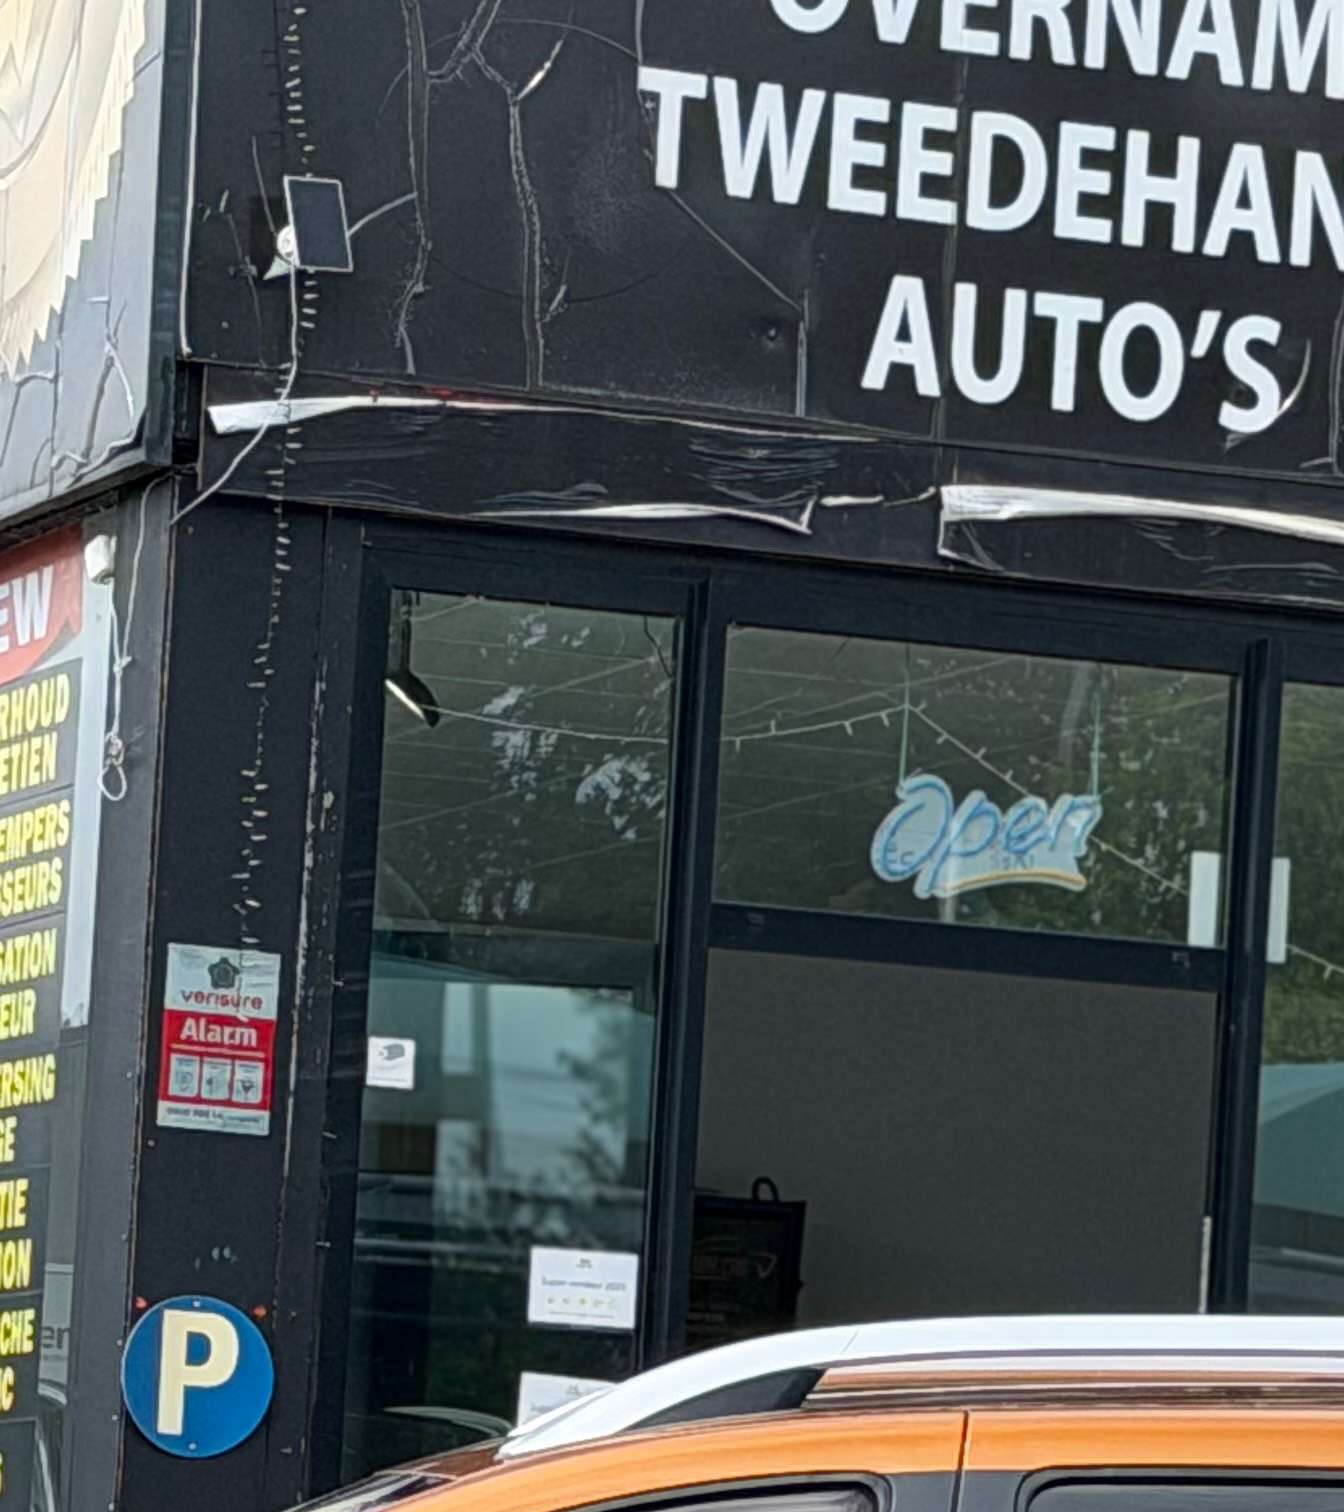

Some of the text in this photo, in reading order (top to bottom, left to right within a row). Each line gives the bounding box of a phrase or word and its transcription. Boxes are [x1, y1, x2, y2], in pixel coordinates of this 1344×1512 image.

[861, 275, 1283, 433] AUTO'S
[873, 775, 1102, 898] Open
[180, 1017, 258, 1047] Alarm
[181, 989, 263, 1010] verisure
[157, 1309, 239, 1435] P
